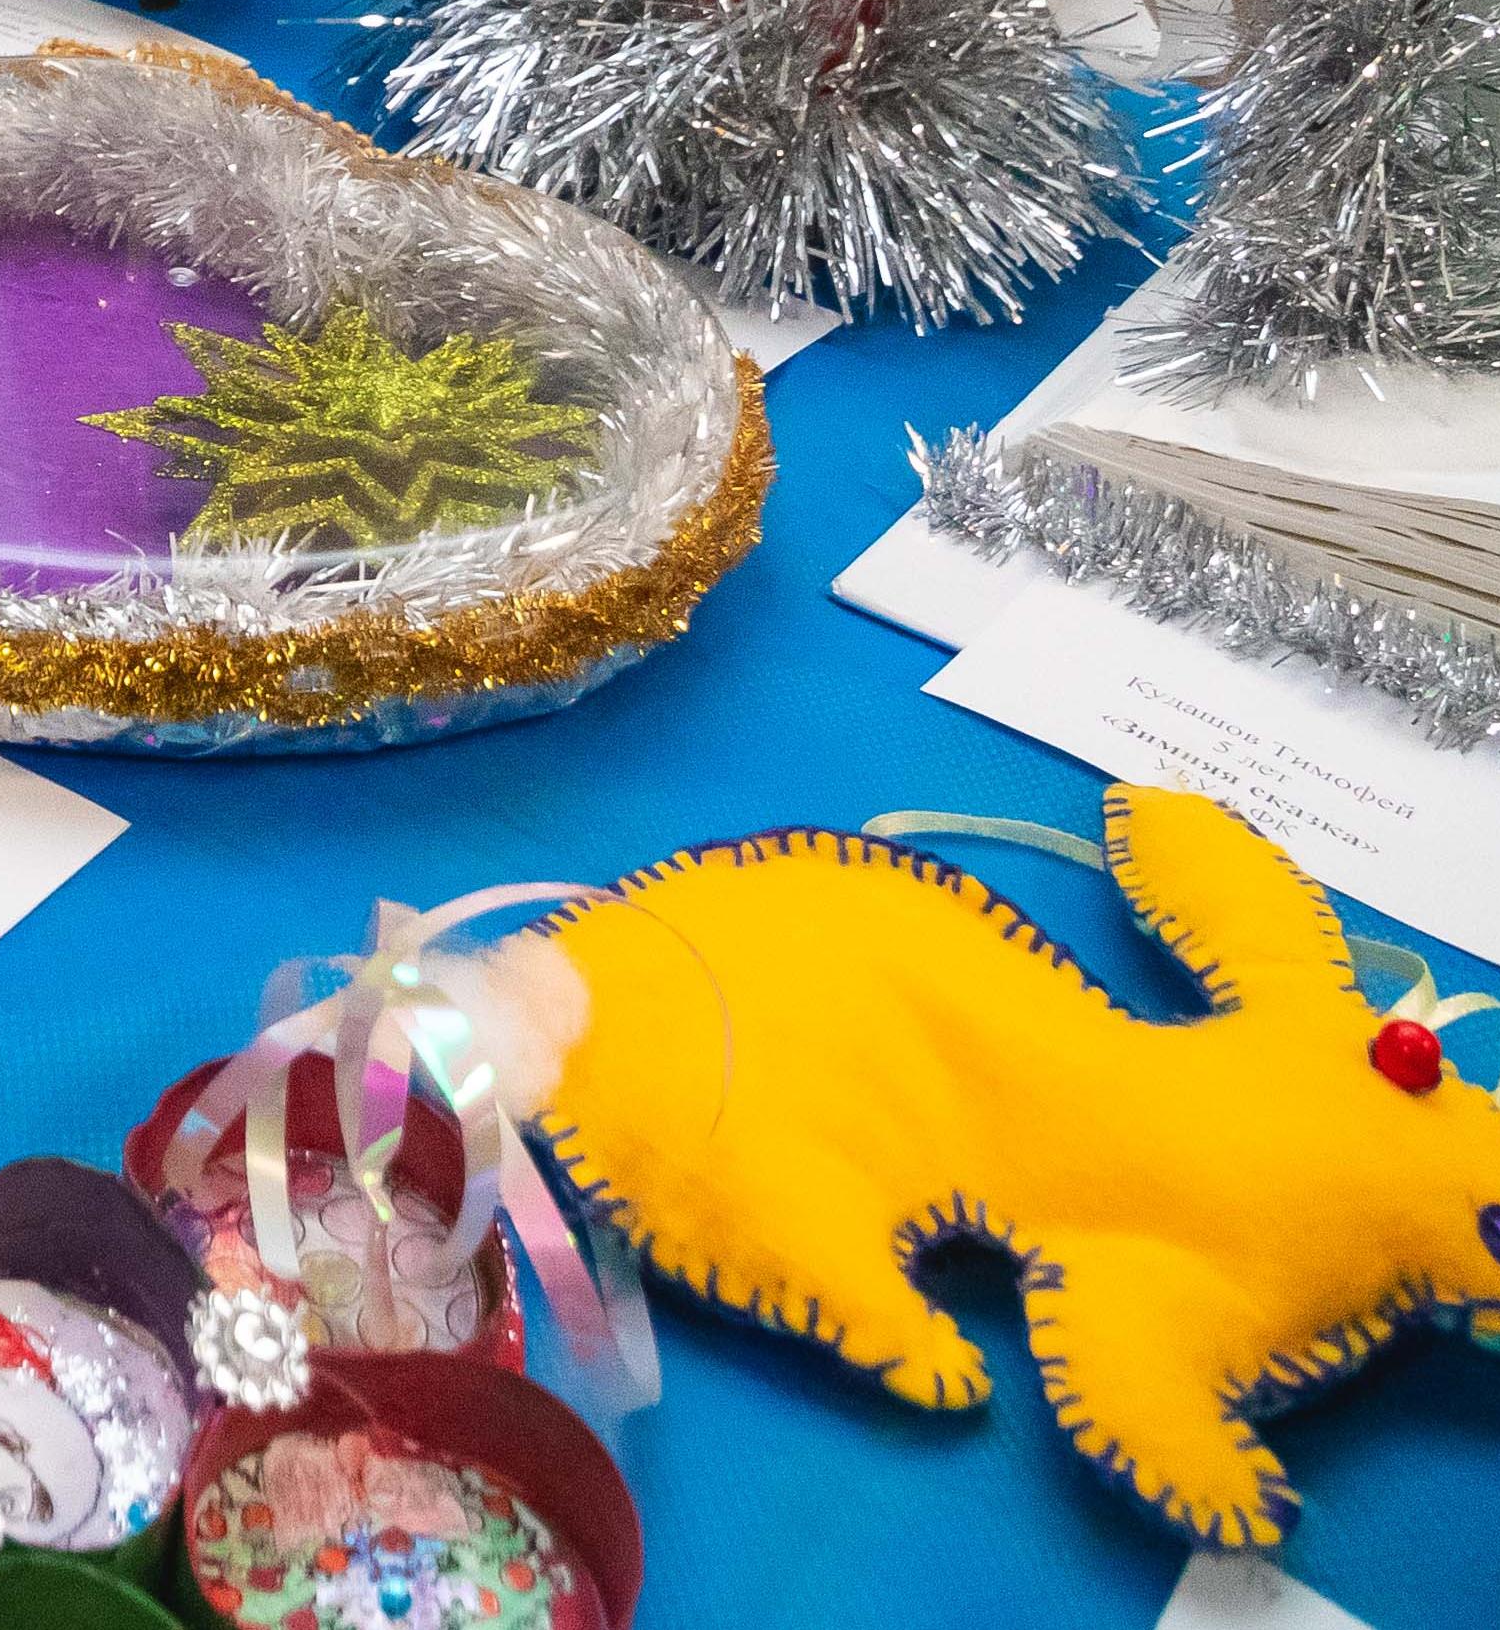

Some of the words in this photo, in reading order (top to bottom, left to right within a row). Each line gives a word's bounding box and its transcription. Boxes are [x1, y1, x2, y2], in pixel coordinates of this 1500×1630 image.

[1102, 714, 1241, 786] «Зимняя
[1249, 785, 1381, 855] сказка»
[1126, 676, 1261, 746] Кудашов
[1272, 740, 1416, 820] Тимофей
[1211, 740, 1234, 754] 5
[1237, 753, 1294, 784] лет
[1249, 807, 1299, 838] ФК
